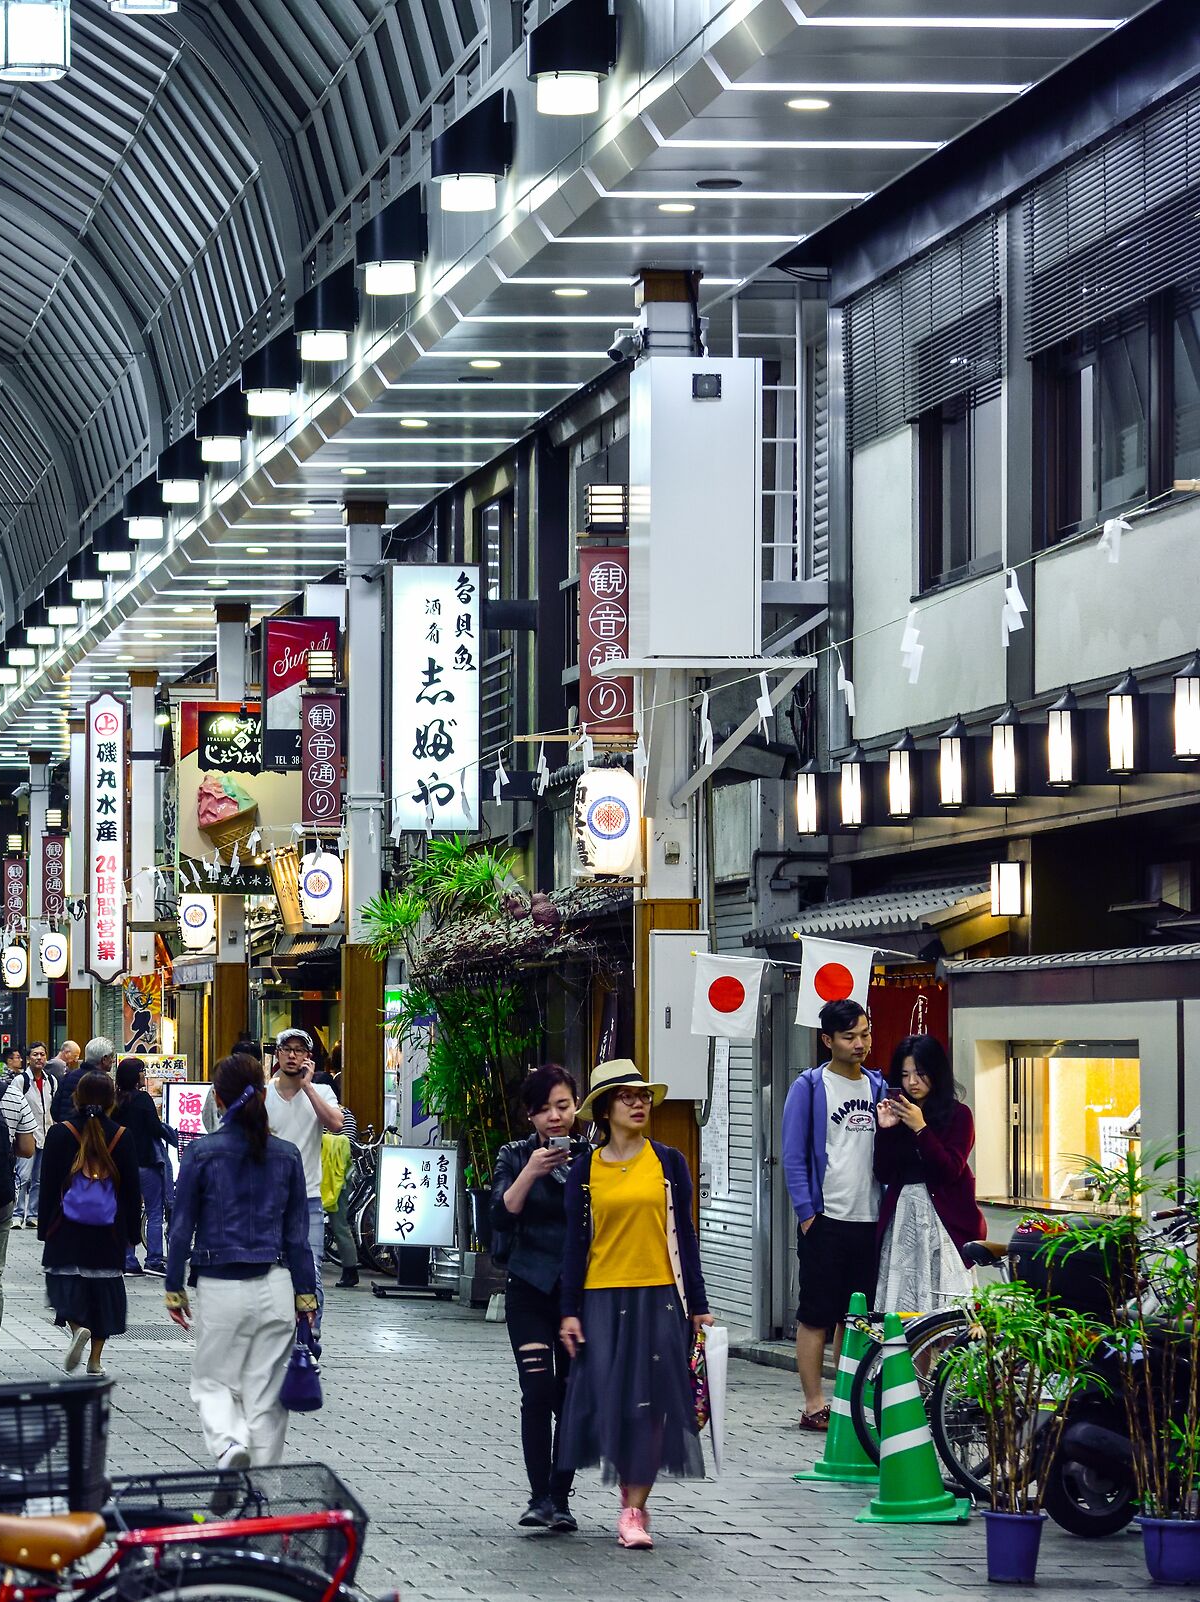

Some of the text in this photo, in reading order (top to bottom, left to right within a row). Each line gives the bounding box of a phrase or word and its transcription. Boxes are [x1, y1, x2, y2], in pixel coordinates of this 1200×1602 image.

[588, 561, 628, 720] 観音通り
[96, 742, 118, 843] 磯丸水産
[274, 756, 302, 765] TEL 38
[307, 704, 336, 818] 観音通り
[7, 864, 24, 927] 観音通り
[46, 841, 63, 911] 観音通り
[96, 855, 117, 961] 24時間営業
